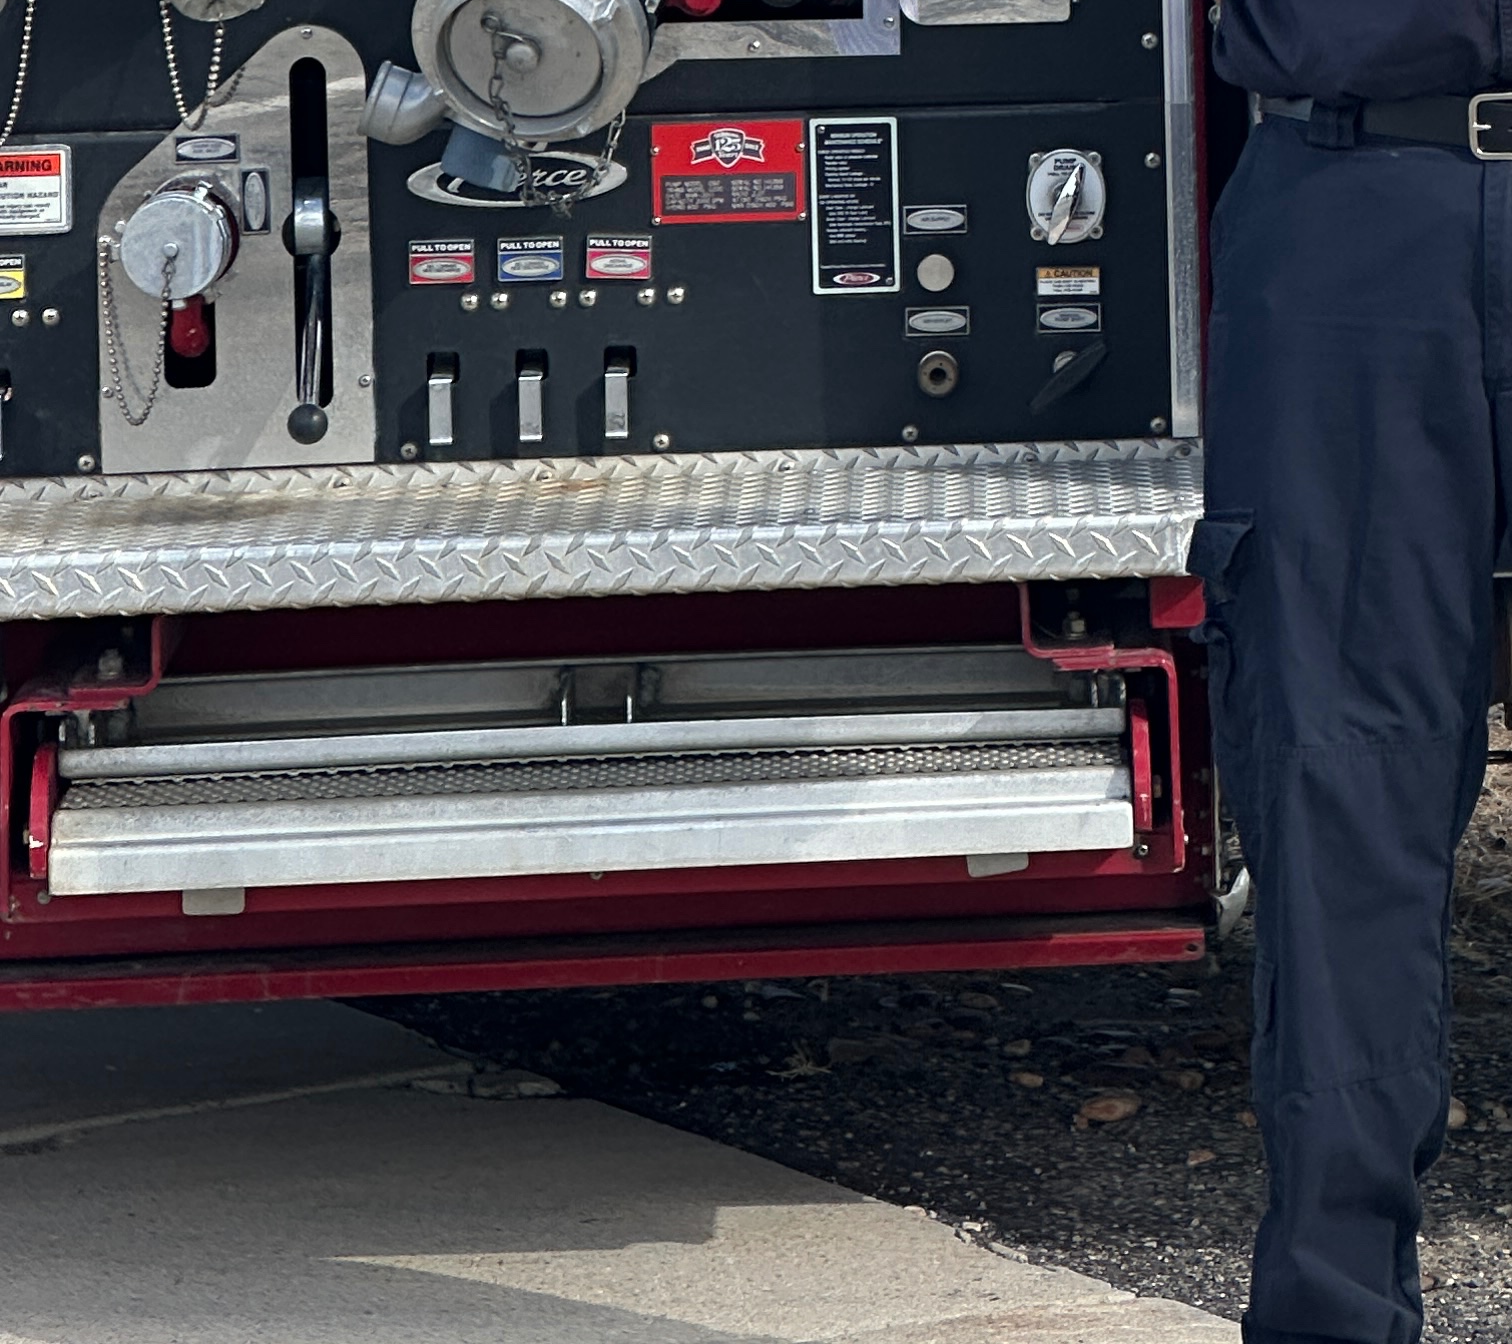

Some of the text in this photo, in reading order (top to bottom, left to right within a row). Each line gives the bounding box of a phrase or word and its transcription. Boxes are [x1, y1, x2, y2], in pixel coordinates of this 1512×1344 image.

[715, 136, 741, 152] 125
[412, 244, 434, 252] PULL
[447, 243, 471, 251] OPEN
[500, 242, 523, 250] PULL
[535, 241, 560, 249] OPEN
[589, 240, 611, 248] PULL
[625, 240, 649, 248] OPEN
